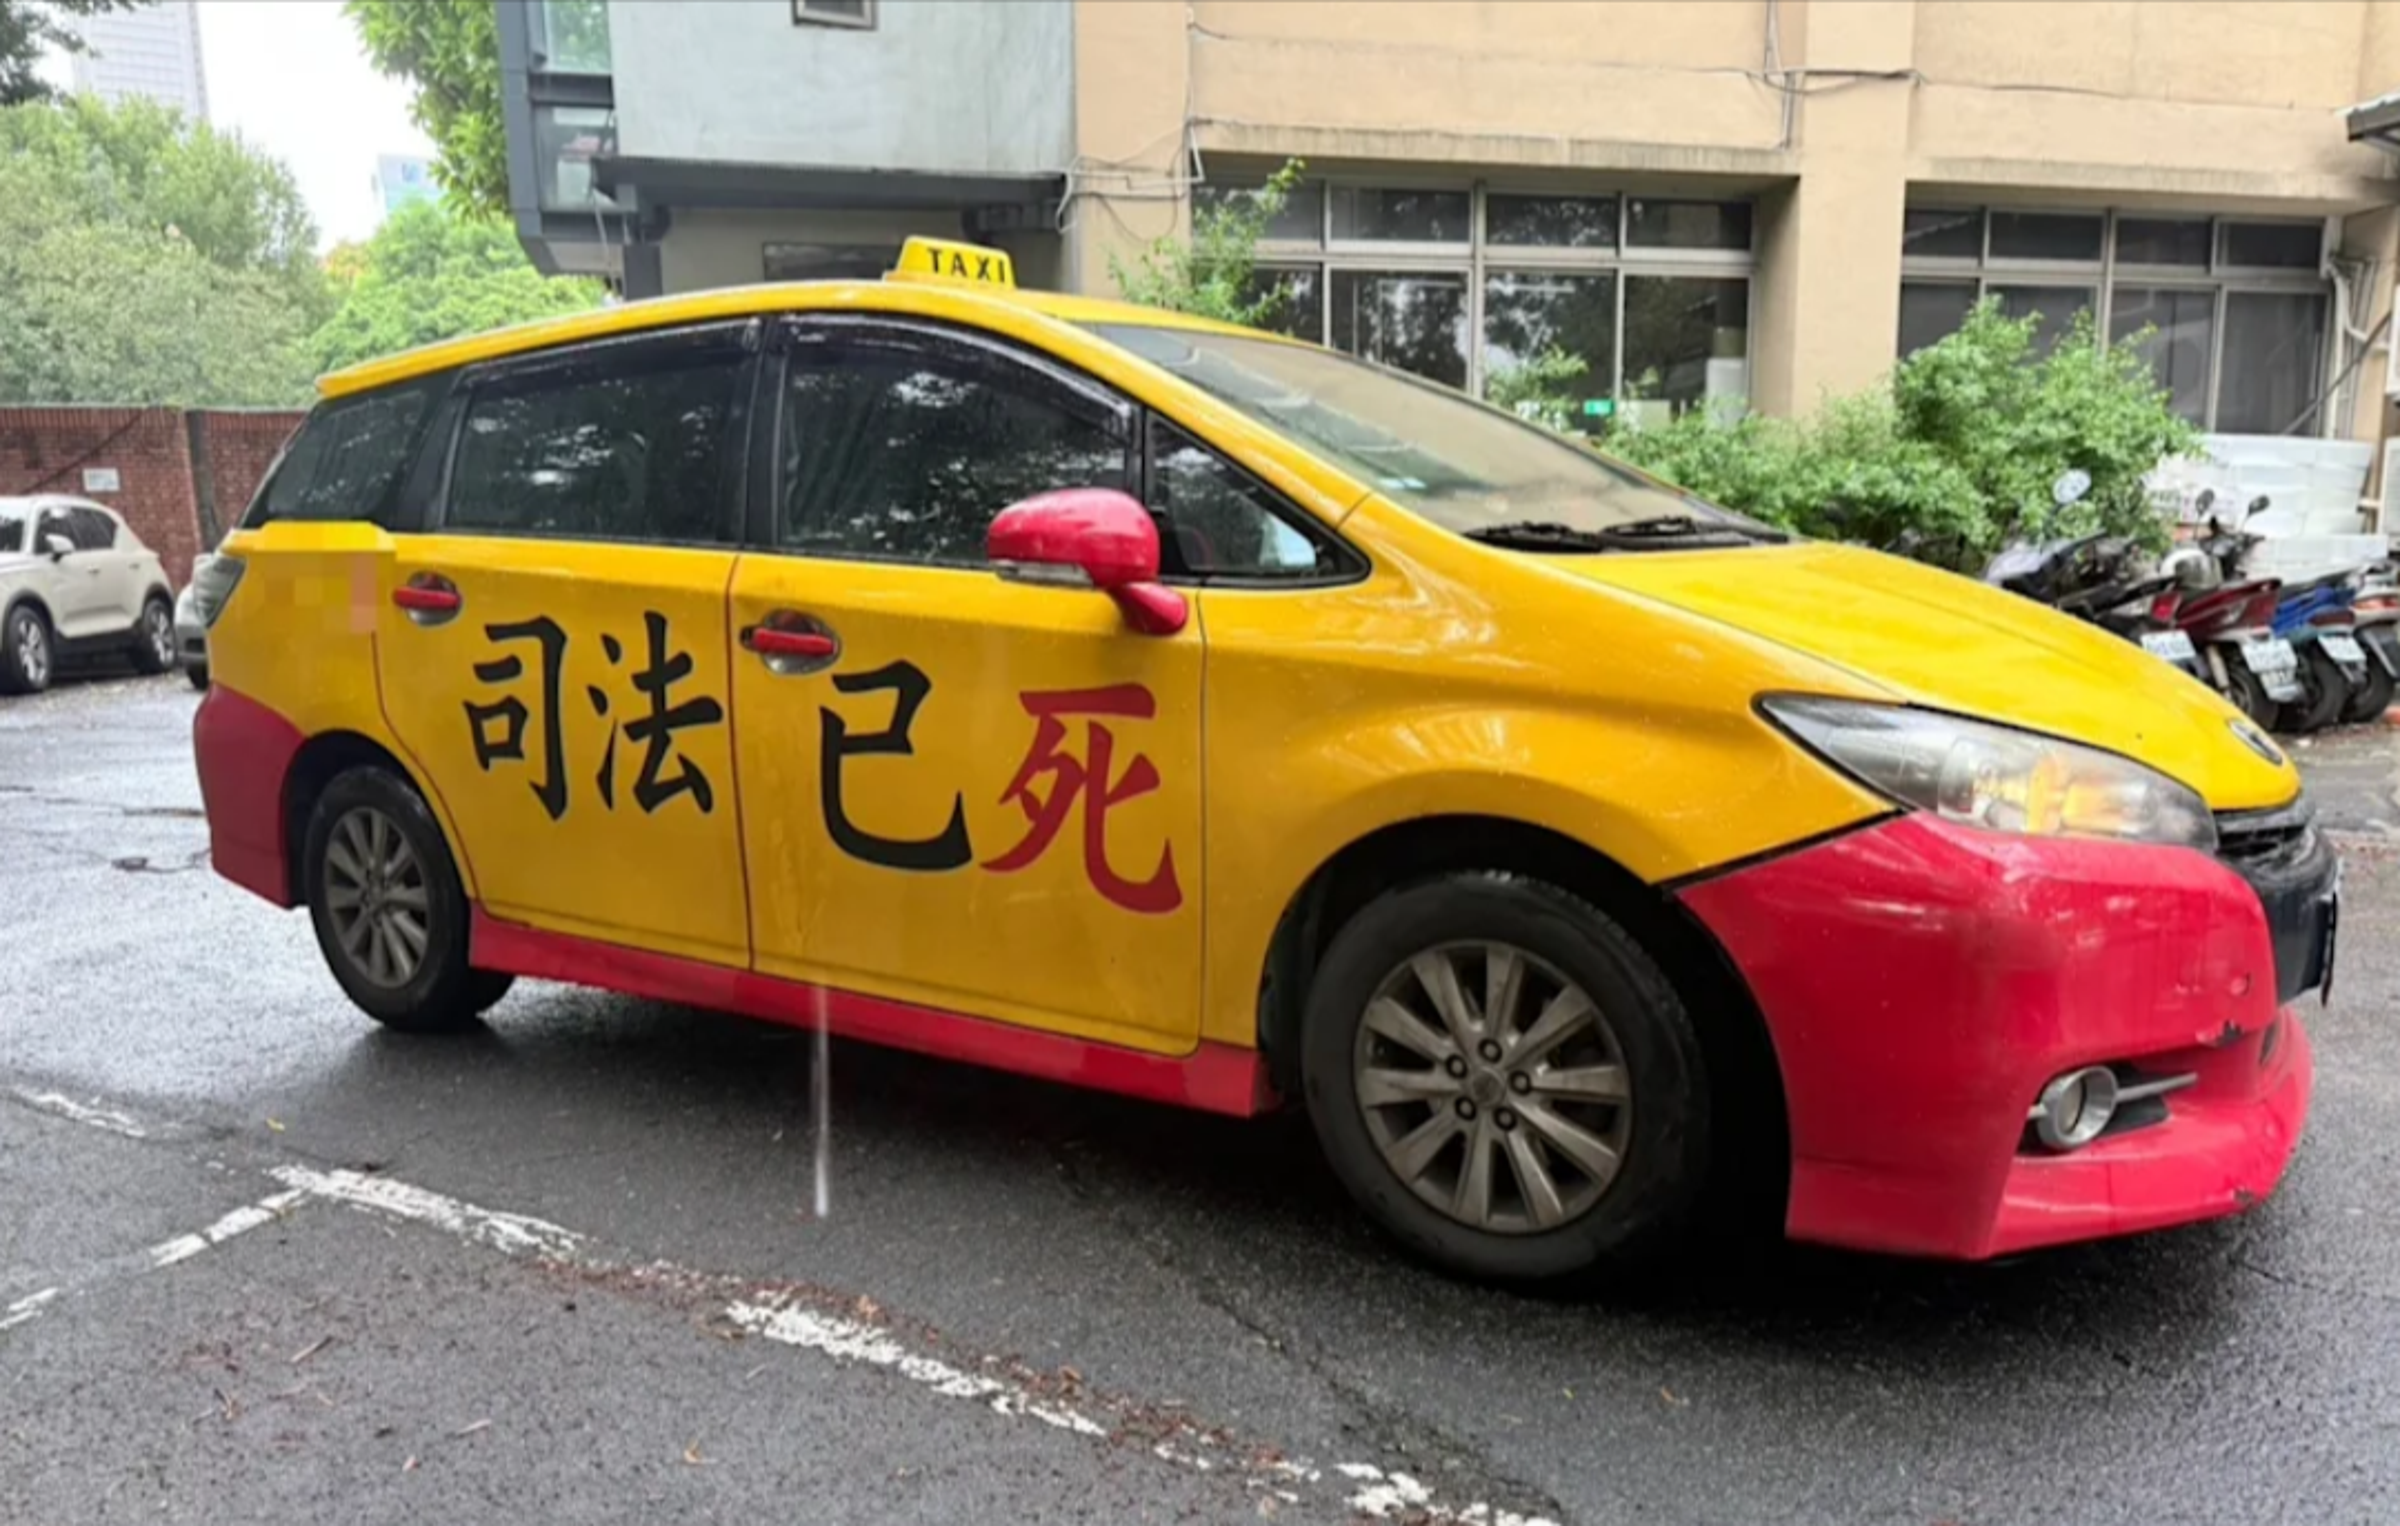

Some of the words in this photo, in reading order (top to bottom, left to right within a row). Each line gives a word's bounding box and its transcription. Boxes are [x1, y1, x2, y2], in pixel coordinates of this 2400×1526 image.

[927, 248, 1006, 283] TAXI
[463, 610, 1184, 915] 司法已死
